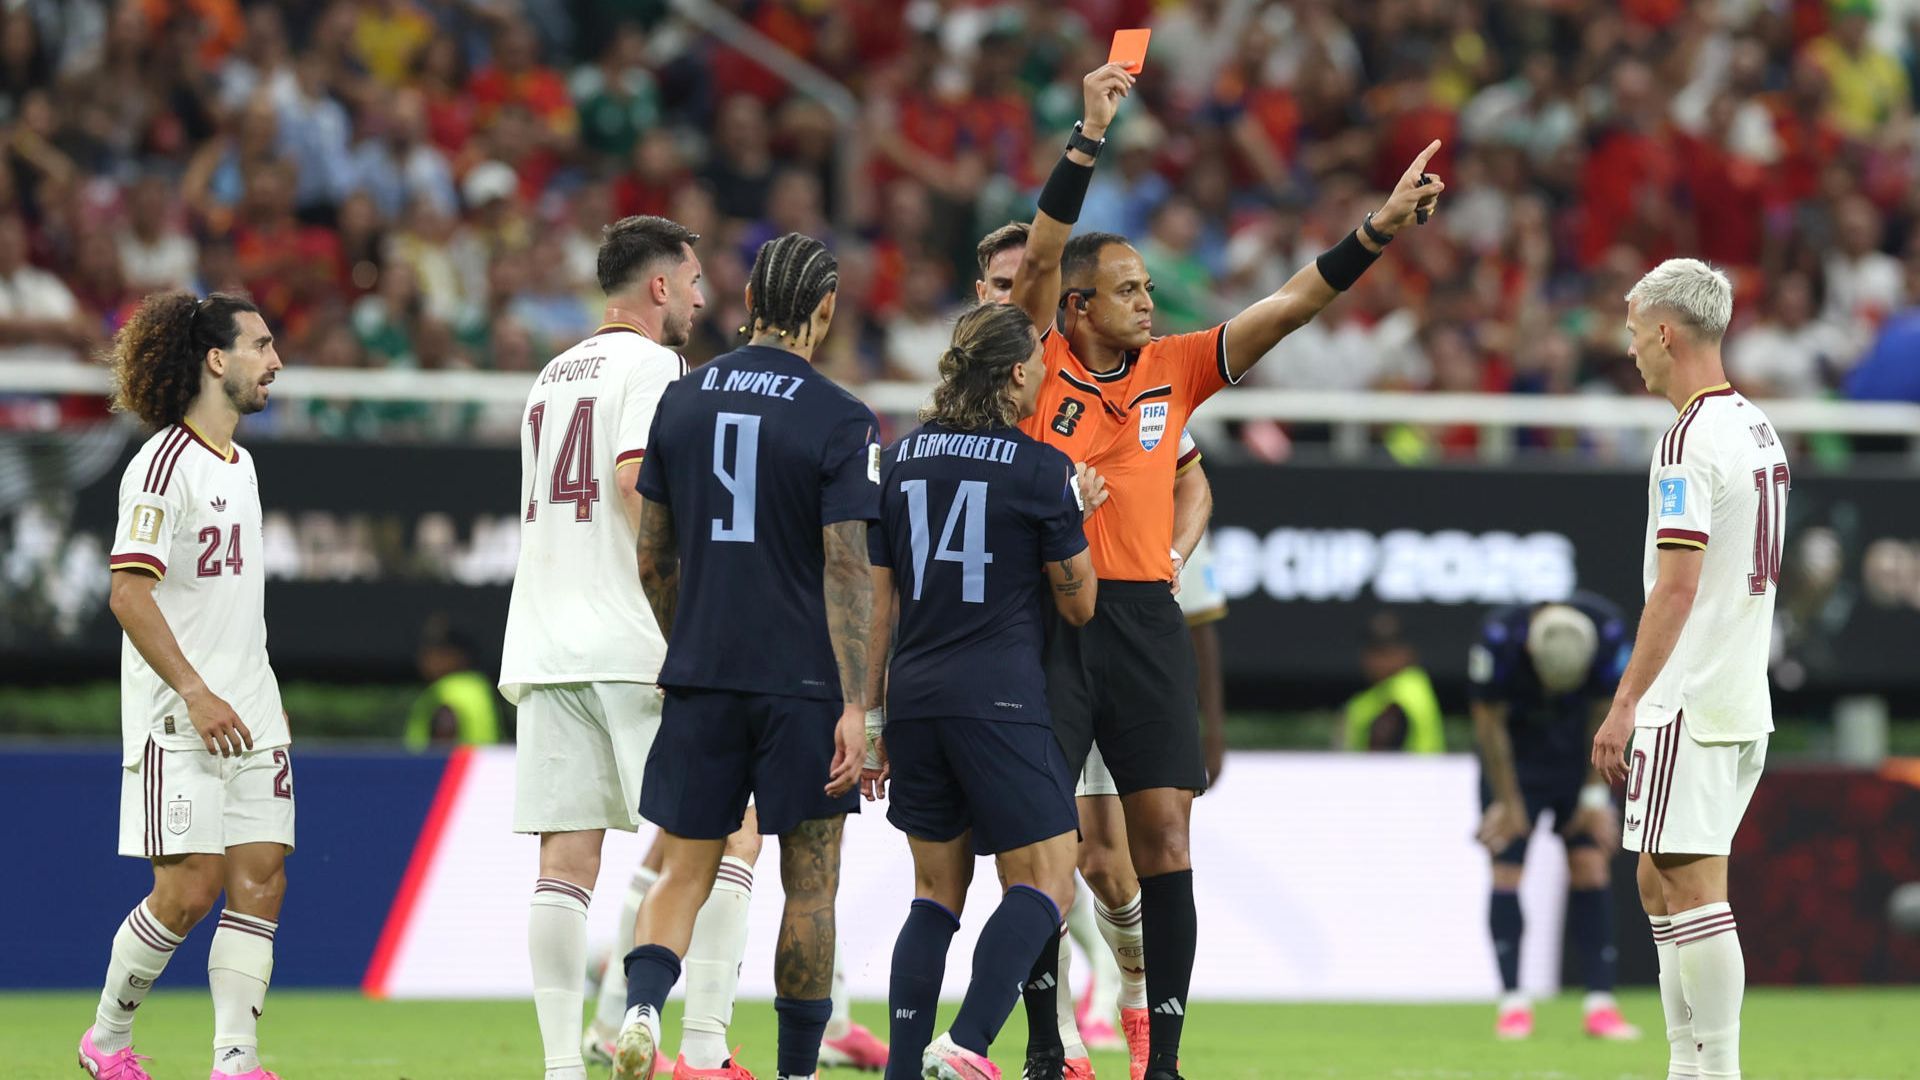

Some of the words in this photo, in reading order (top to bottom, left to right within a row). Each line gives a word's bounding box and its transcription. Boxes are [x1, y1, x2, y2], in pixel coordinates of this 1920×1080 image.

[541, 357, 607, 386] LAPORTE
[701, 366, 719, 391] D.
[723, 369, 804, 401] NUÑEZ
[1141, 424, 1164, 433] REFEREE
[1143, 405, 1166, 418] FIFA
[526, 397, 600, 522] 14
[896, 438, 911, 463] A.
[913, 433, 1018, 464] CANOBBIO
[711, 412, 761, 543] 9
[196, 523, 243, 579] 24
[900, 479, 994, 603] 14
[1748, 462, 1791, 596] 10
